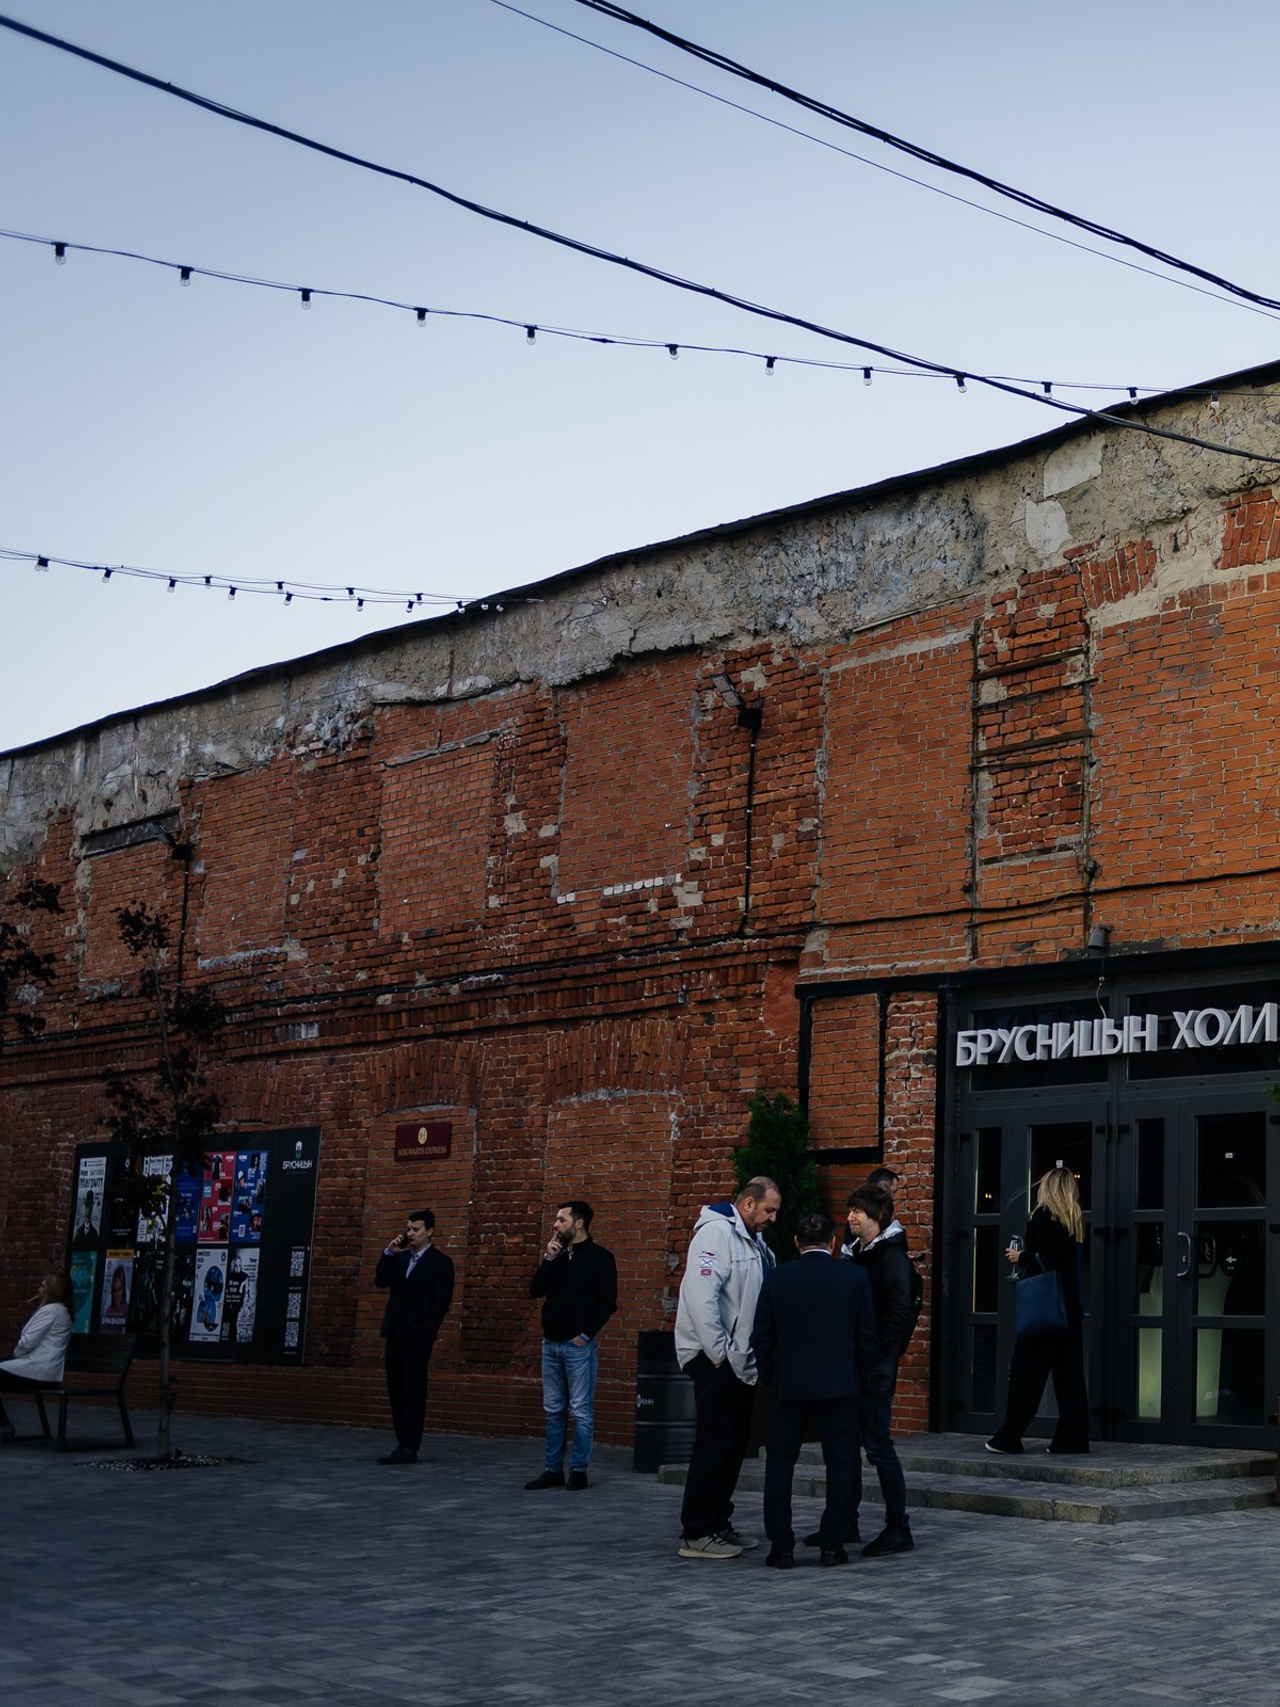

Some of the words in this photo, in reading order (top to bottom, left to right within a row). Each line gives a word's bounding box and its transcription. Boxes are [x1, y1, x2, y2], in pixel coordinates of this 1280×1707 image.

[956, 1014, 1159, 1066] БРУСНИЦЫН
[1172, 1002, 1278, 1049] ХОЛЛ
[398, 1147, 424, 1157] HOGWARTS
[425, 1146, 447, 1154] EXPRESS
[282, 1159, 313, 1170] БРУСНИЦЫН
